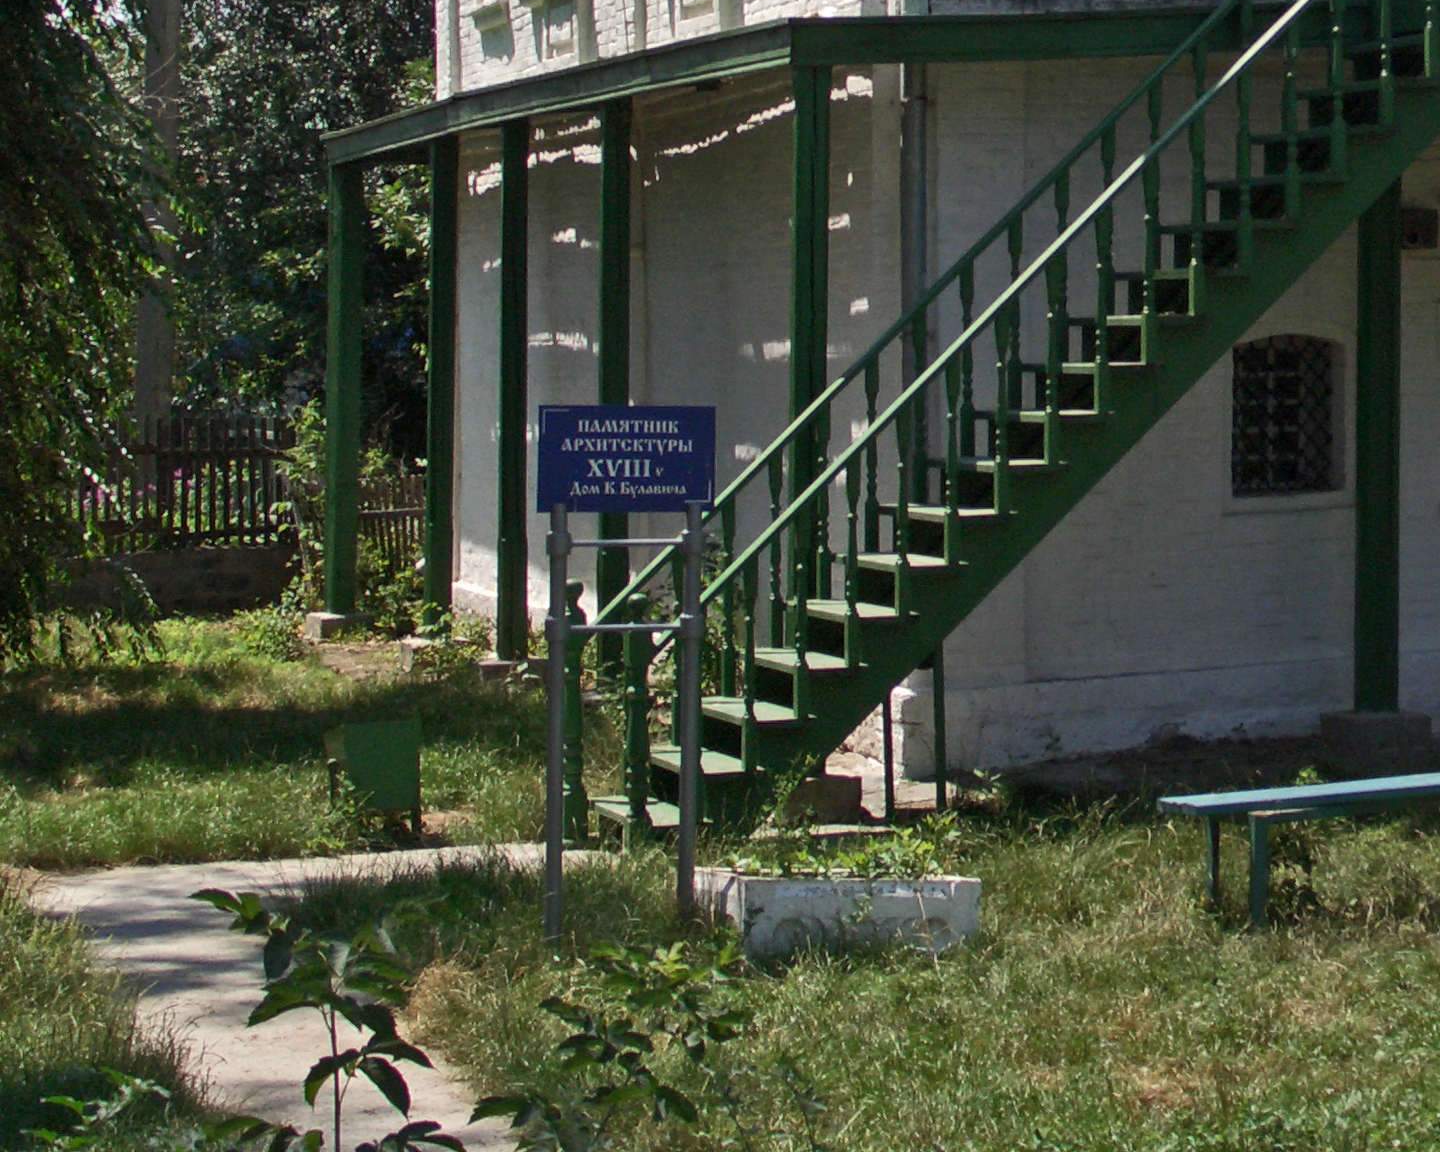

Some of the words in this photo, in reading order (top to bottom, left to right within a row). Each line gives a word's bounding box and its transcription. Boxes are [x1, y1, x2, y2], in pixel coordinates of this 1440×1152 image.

[578, 419, 679, 434] ПАМЯТНИК
[586, 458, 652, 478] XVIII
[569, 480, 601, 497] Дом
[603, 481, 616, 495] К
